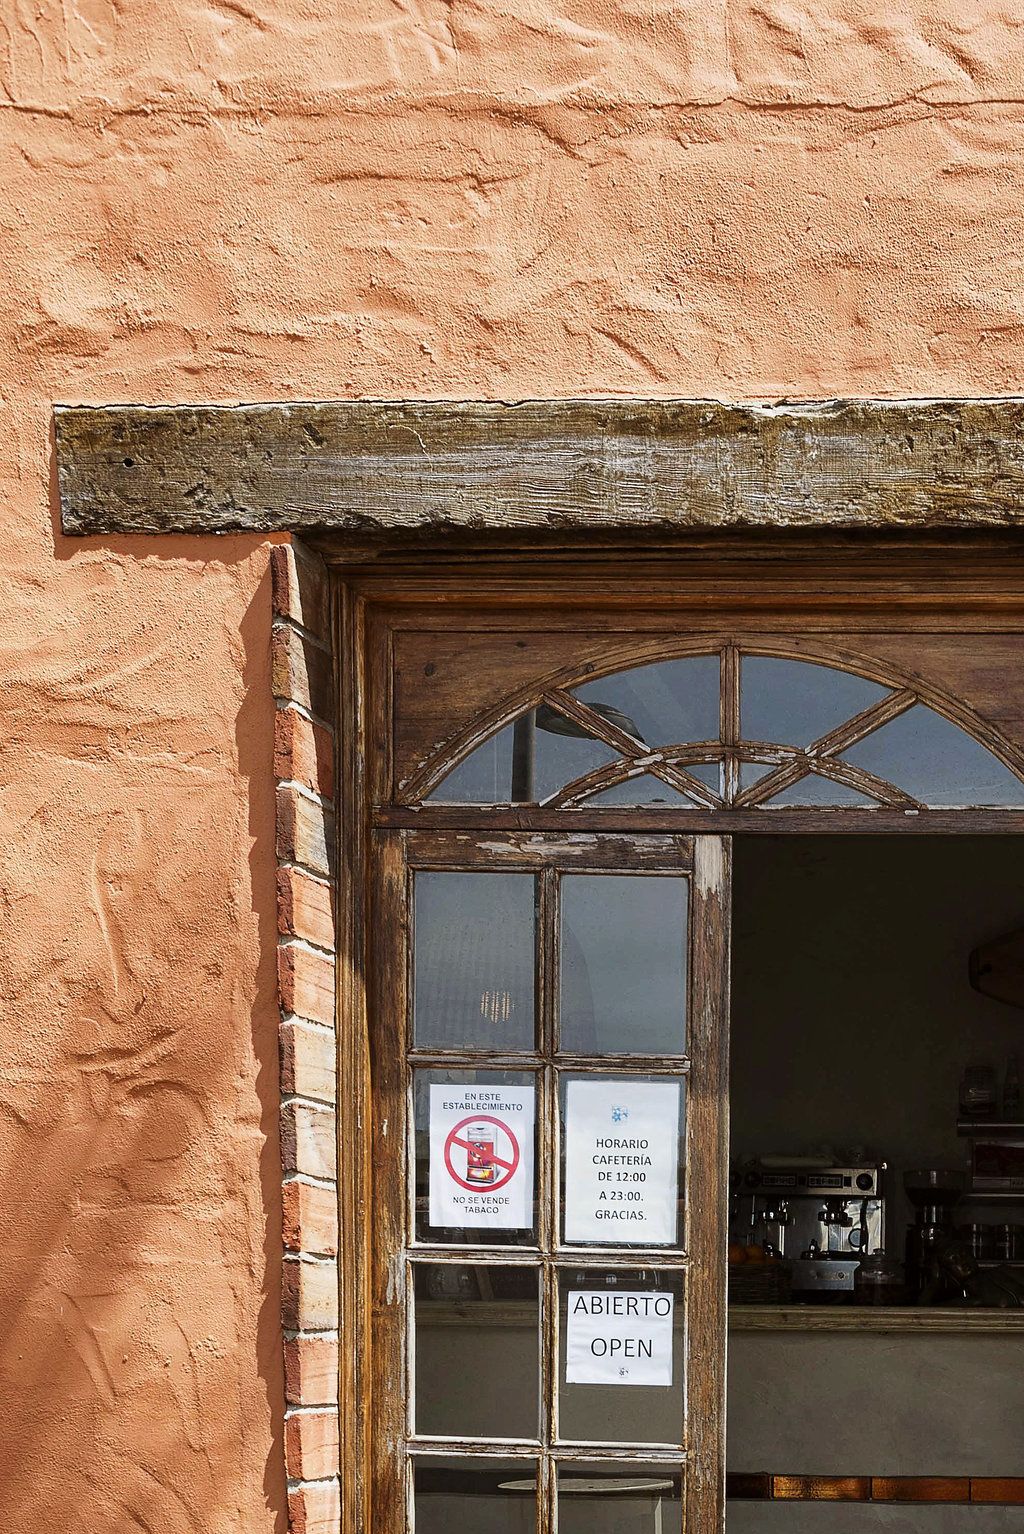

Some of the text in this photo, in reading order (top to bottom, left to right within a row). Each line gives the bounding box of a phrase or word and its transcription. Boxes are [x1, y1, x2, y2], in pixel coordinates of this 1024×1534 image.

[465, 1093, 501, 1101] EN ESTE
[443, 1102, 523, 1111] ESTABLECIMIENTO
[596, 1138, 649, 1149] HORARIO
[592, 1154, 652, 1166] CAFETERÍA
[598, 1172, 647, 1182] DE 12:00
[481, 1197, 510, 1205] VENDE
[599, 1191, 644, 1202] A 23:00.
[464, 1206, 499, 1214] TABACO
[595, 1210, 647, 1221] GRACIAS.
[573, 1296, 671, 1316] ABIERTO
[591, 1338, 652, 1358] OPEN
